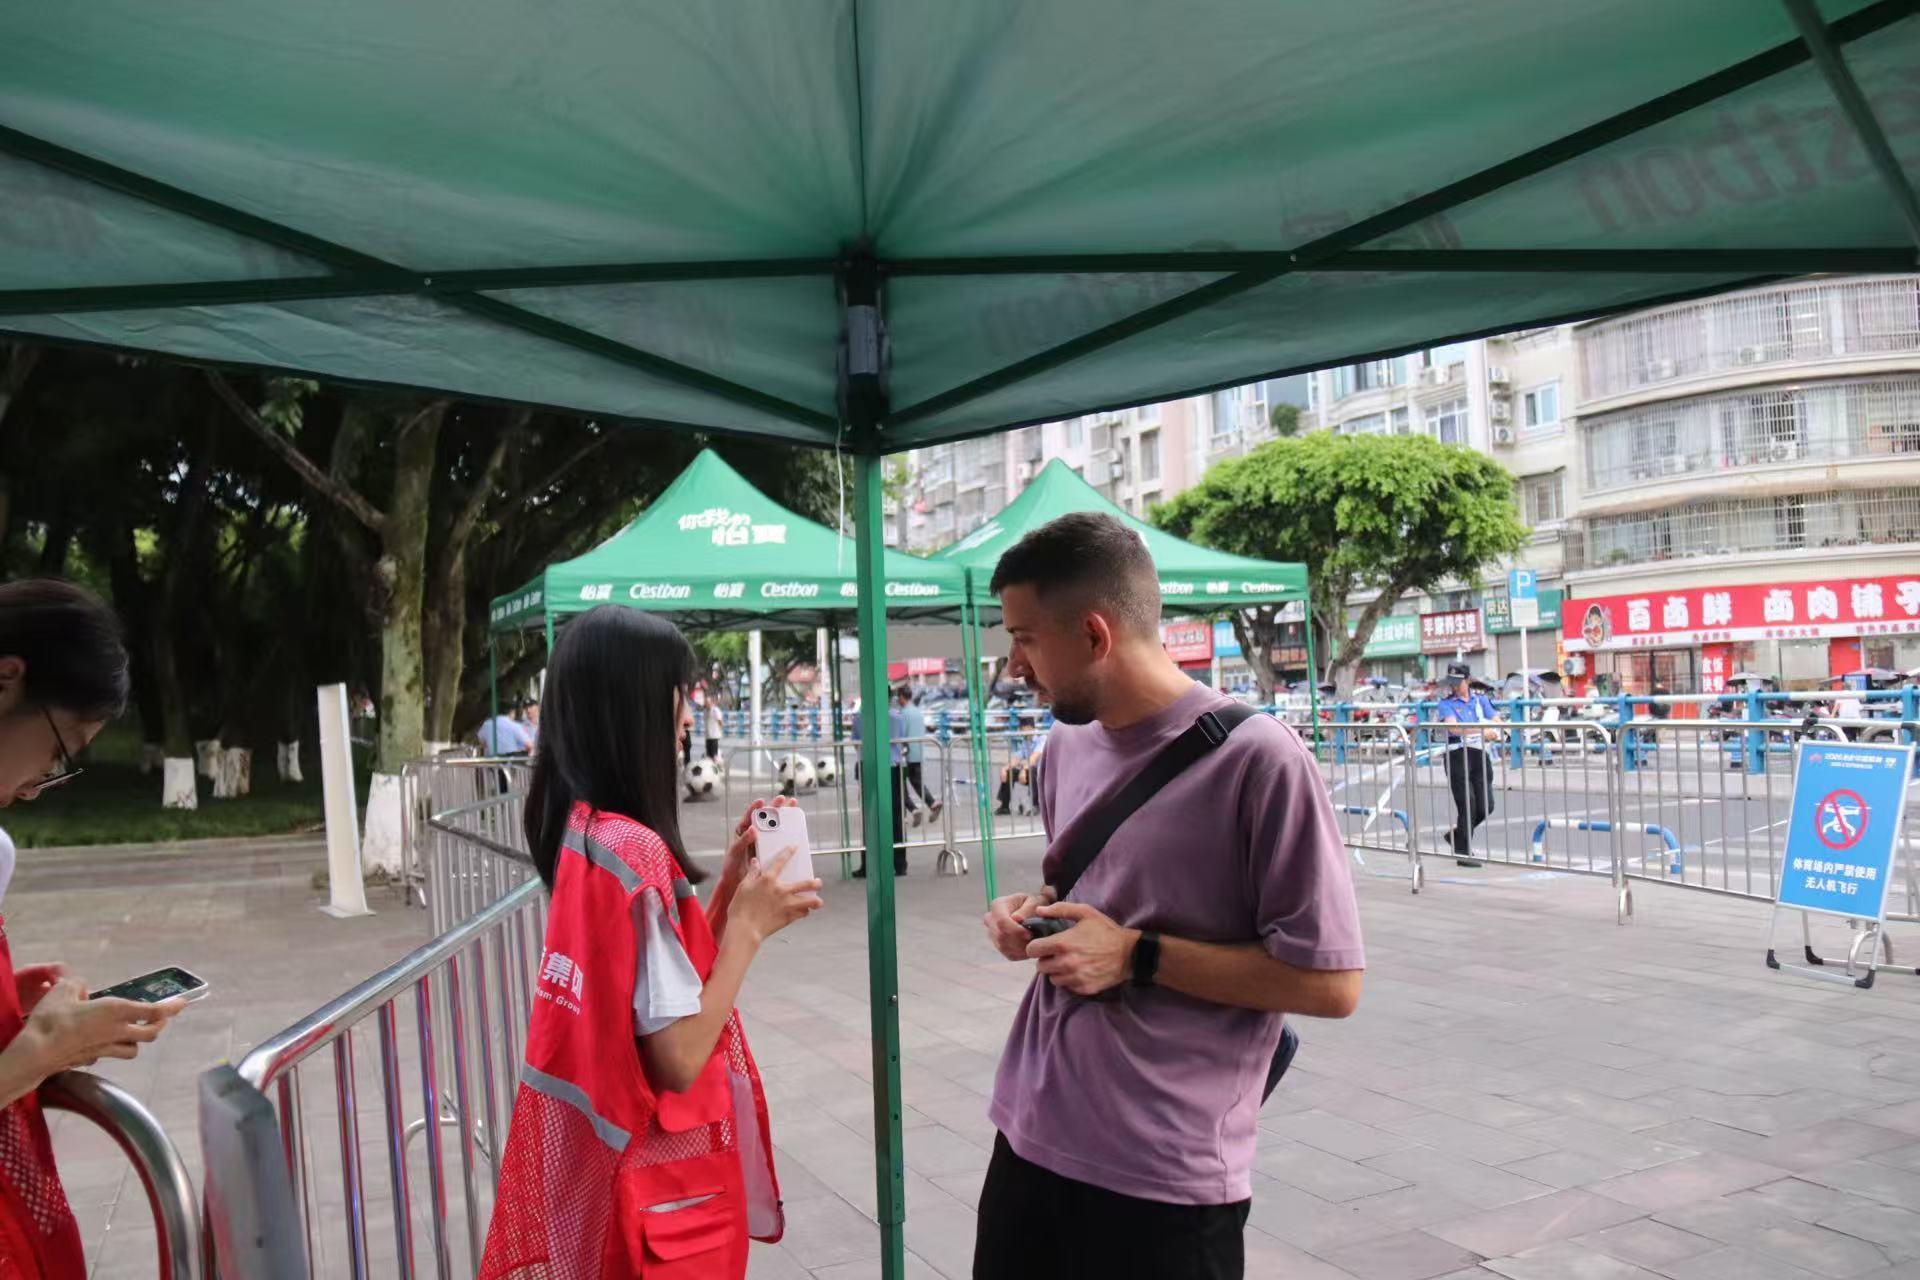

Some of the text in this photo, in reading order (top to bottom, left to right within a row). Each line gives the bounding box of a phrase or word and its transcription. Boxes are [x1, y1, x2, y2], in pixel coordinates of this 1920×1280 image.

[1516, 571, 1531, 597] P
[1626, 592, 1731, 632] 百卤鲜
[1763, 581, 1920, 623] 卤肉铺子
[1793, 857, 1877, 880] 体育场内严禁使用
[1805, 876, 1859, 895] 无人机飞行
